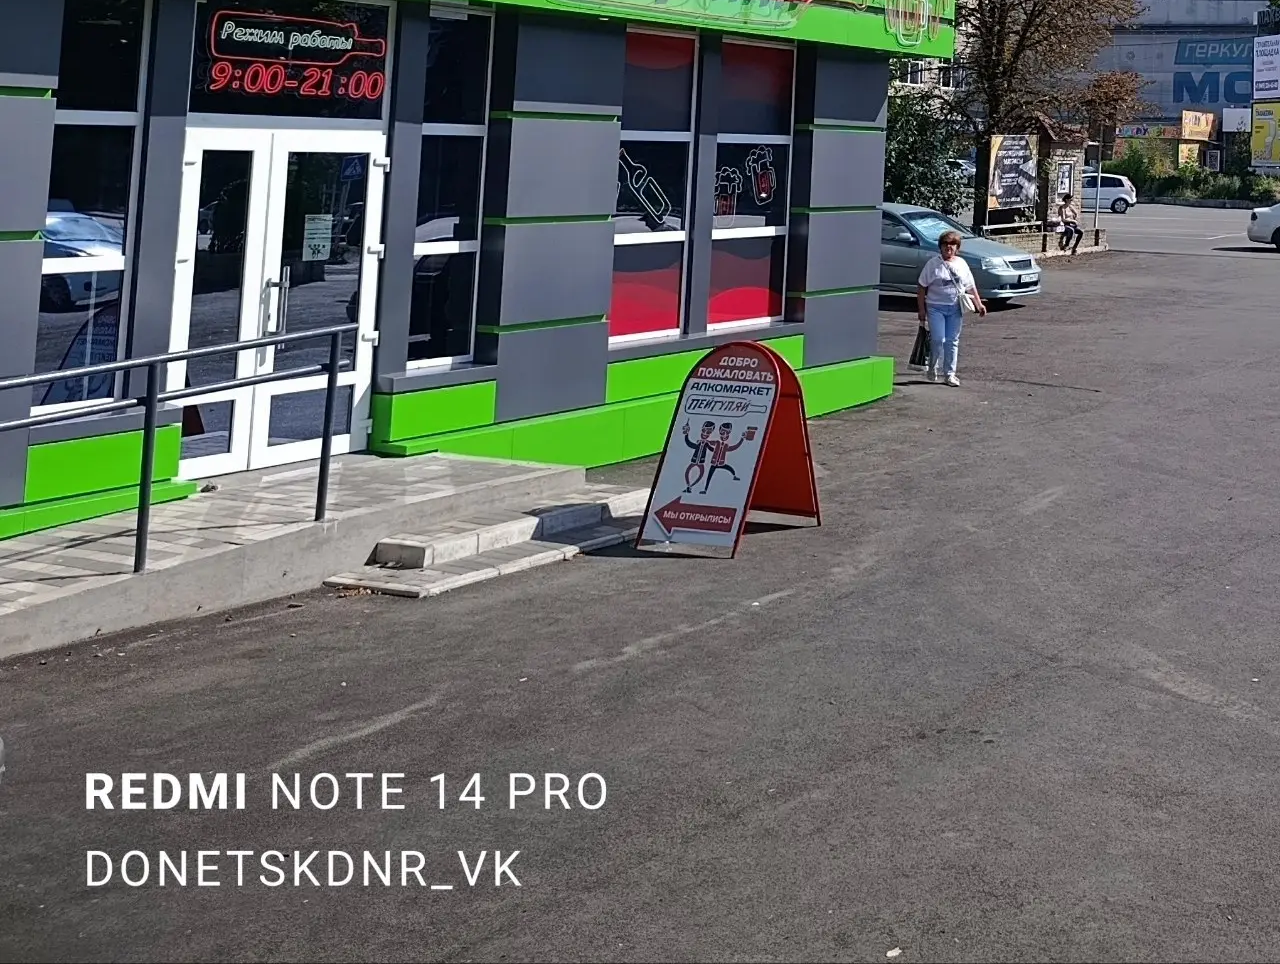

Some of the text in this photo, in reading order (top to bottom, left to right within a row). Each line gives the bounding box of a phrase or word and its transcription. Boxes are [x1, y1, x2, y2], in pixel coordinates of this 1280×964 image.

[221, 21, 353, 51] Режим работы
[719, 356, 759, 368] ДОБРО
[697, 367, 774, 382] ПОЖАЛОВАТЬ
[690, 382, 773, 396] АЛКОМАРКЕТ
[663, 510, 732, 524] МЫ ОТКРЫЛИСЬ!
